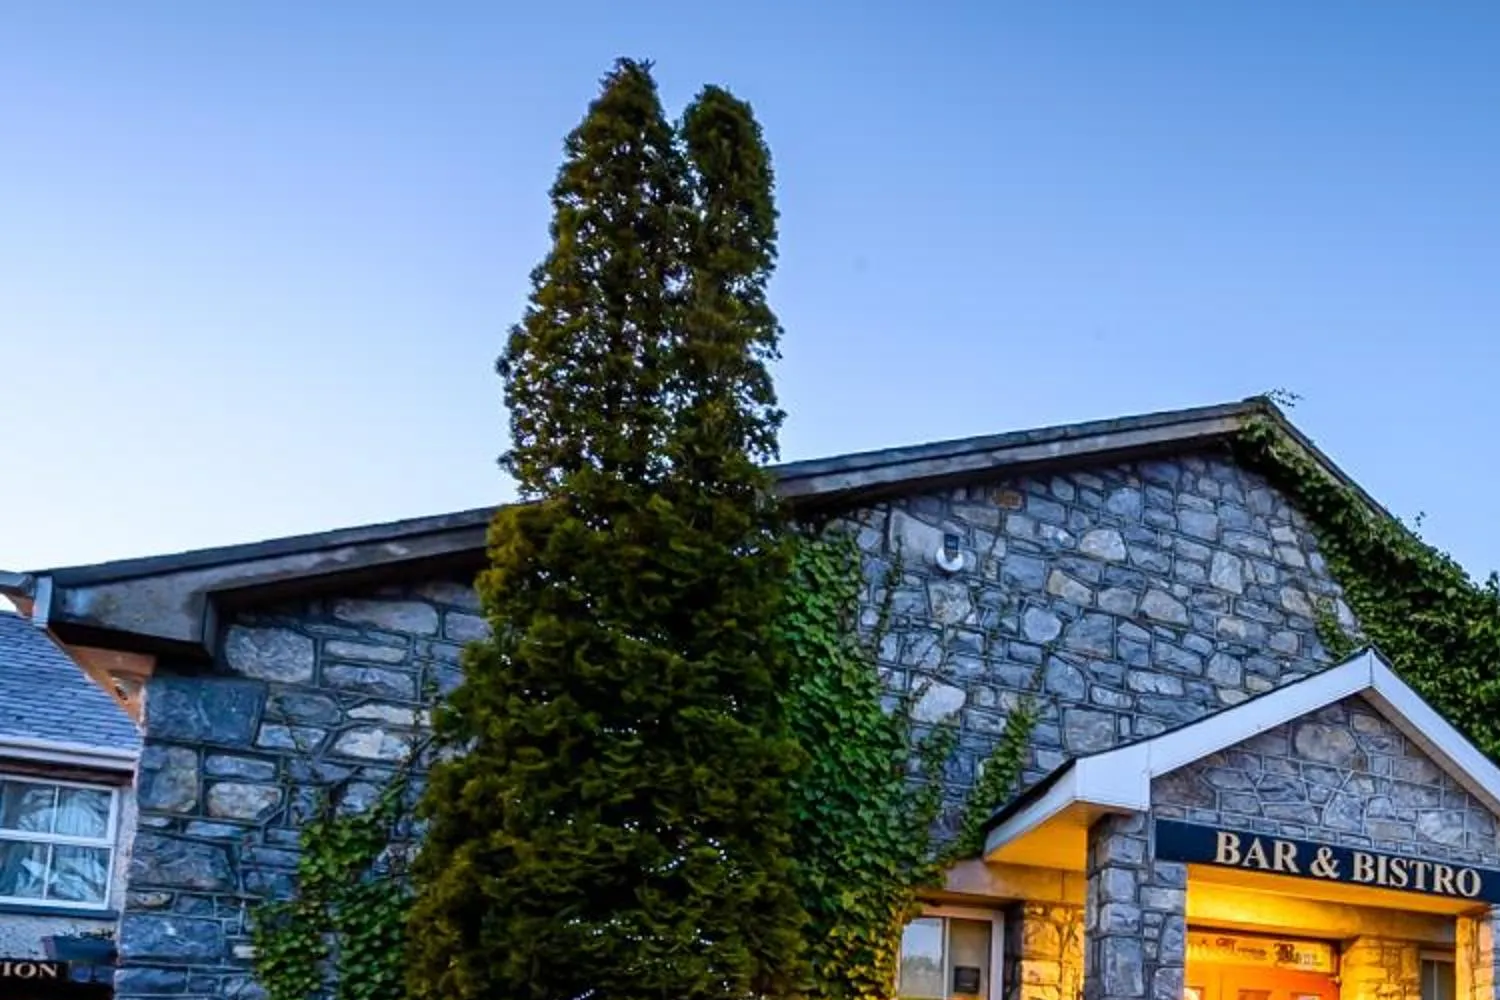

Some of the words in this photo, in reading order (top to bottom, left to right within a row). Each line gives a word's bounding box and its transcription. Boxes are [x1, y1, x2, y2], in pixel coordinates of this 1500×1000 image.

[1214, 831, 1300, 874] BAR
[1310, 847, 1341, 879] &
[1352, 851, 1482, 898] BISTRO
[0, 961, 57, 978] ION
